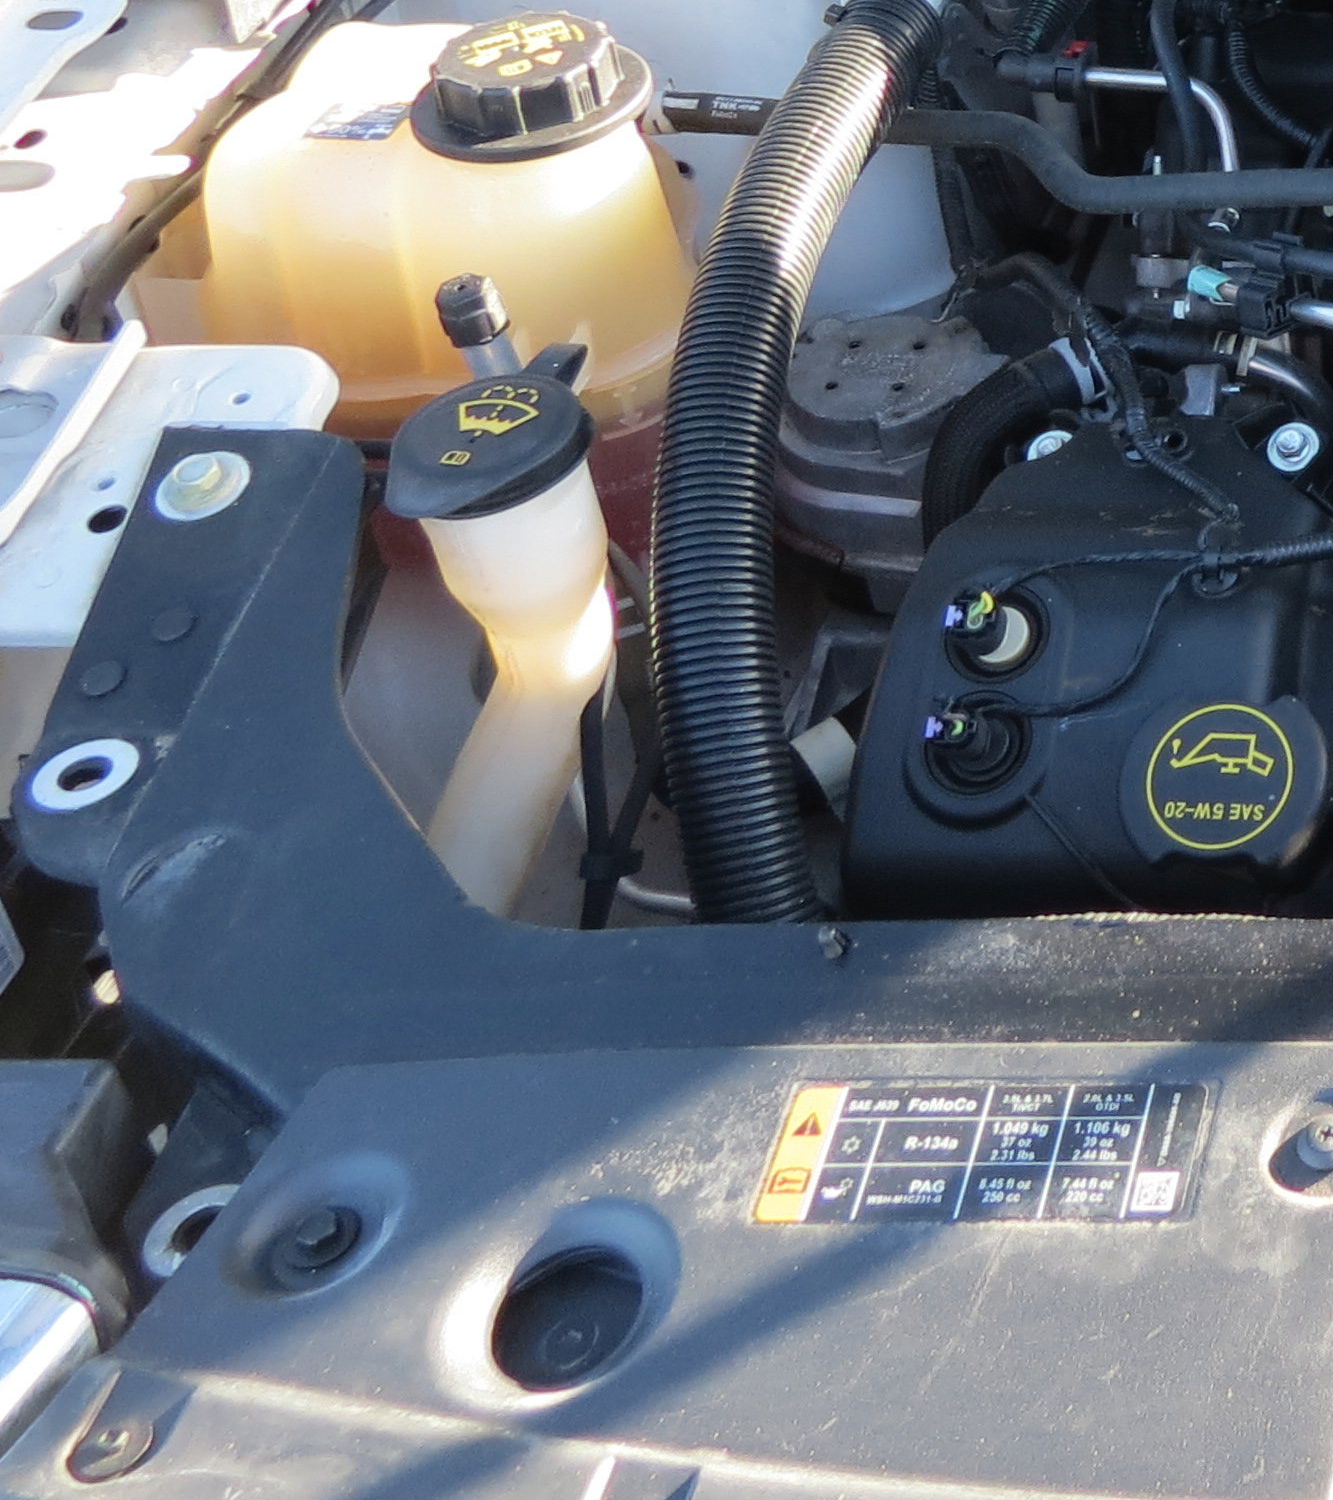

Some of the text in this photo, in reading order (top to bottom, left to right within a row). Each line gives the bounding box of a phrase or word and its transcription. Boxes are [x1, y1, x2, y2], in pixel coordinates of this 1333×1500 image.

[1163, 800, 1266, 822] SAE 5W-20
[848, 1098, 872, 1112] SAE
[906, 1097, 979, 1113] FoMoCo
[992, 1121, 1050, 1137] 1.049 kg
[1074, 1121, 1132, 1138] 1.106 kg
[903, 1135, 960, 1151] R-134a
[1000, 1138, 1033, 1148] 37 oz
[1082, 1137, 1115, 1148] 39 oz
[989, 1149, 1036, 1162] 2.31 lbs
[1071, 1149, 1119, 1162] 2.44 lbs
[908, 1178, 946, 1194] PAG
[981, 1190, 1021, 1204] 250 cc
[1065, 1190, 1106, 1204] 220 cc
